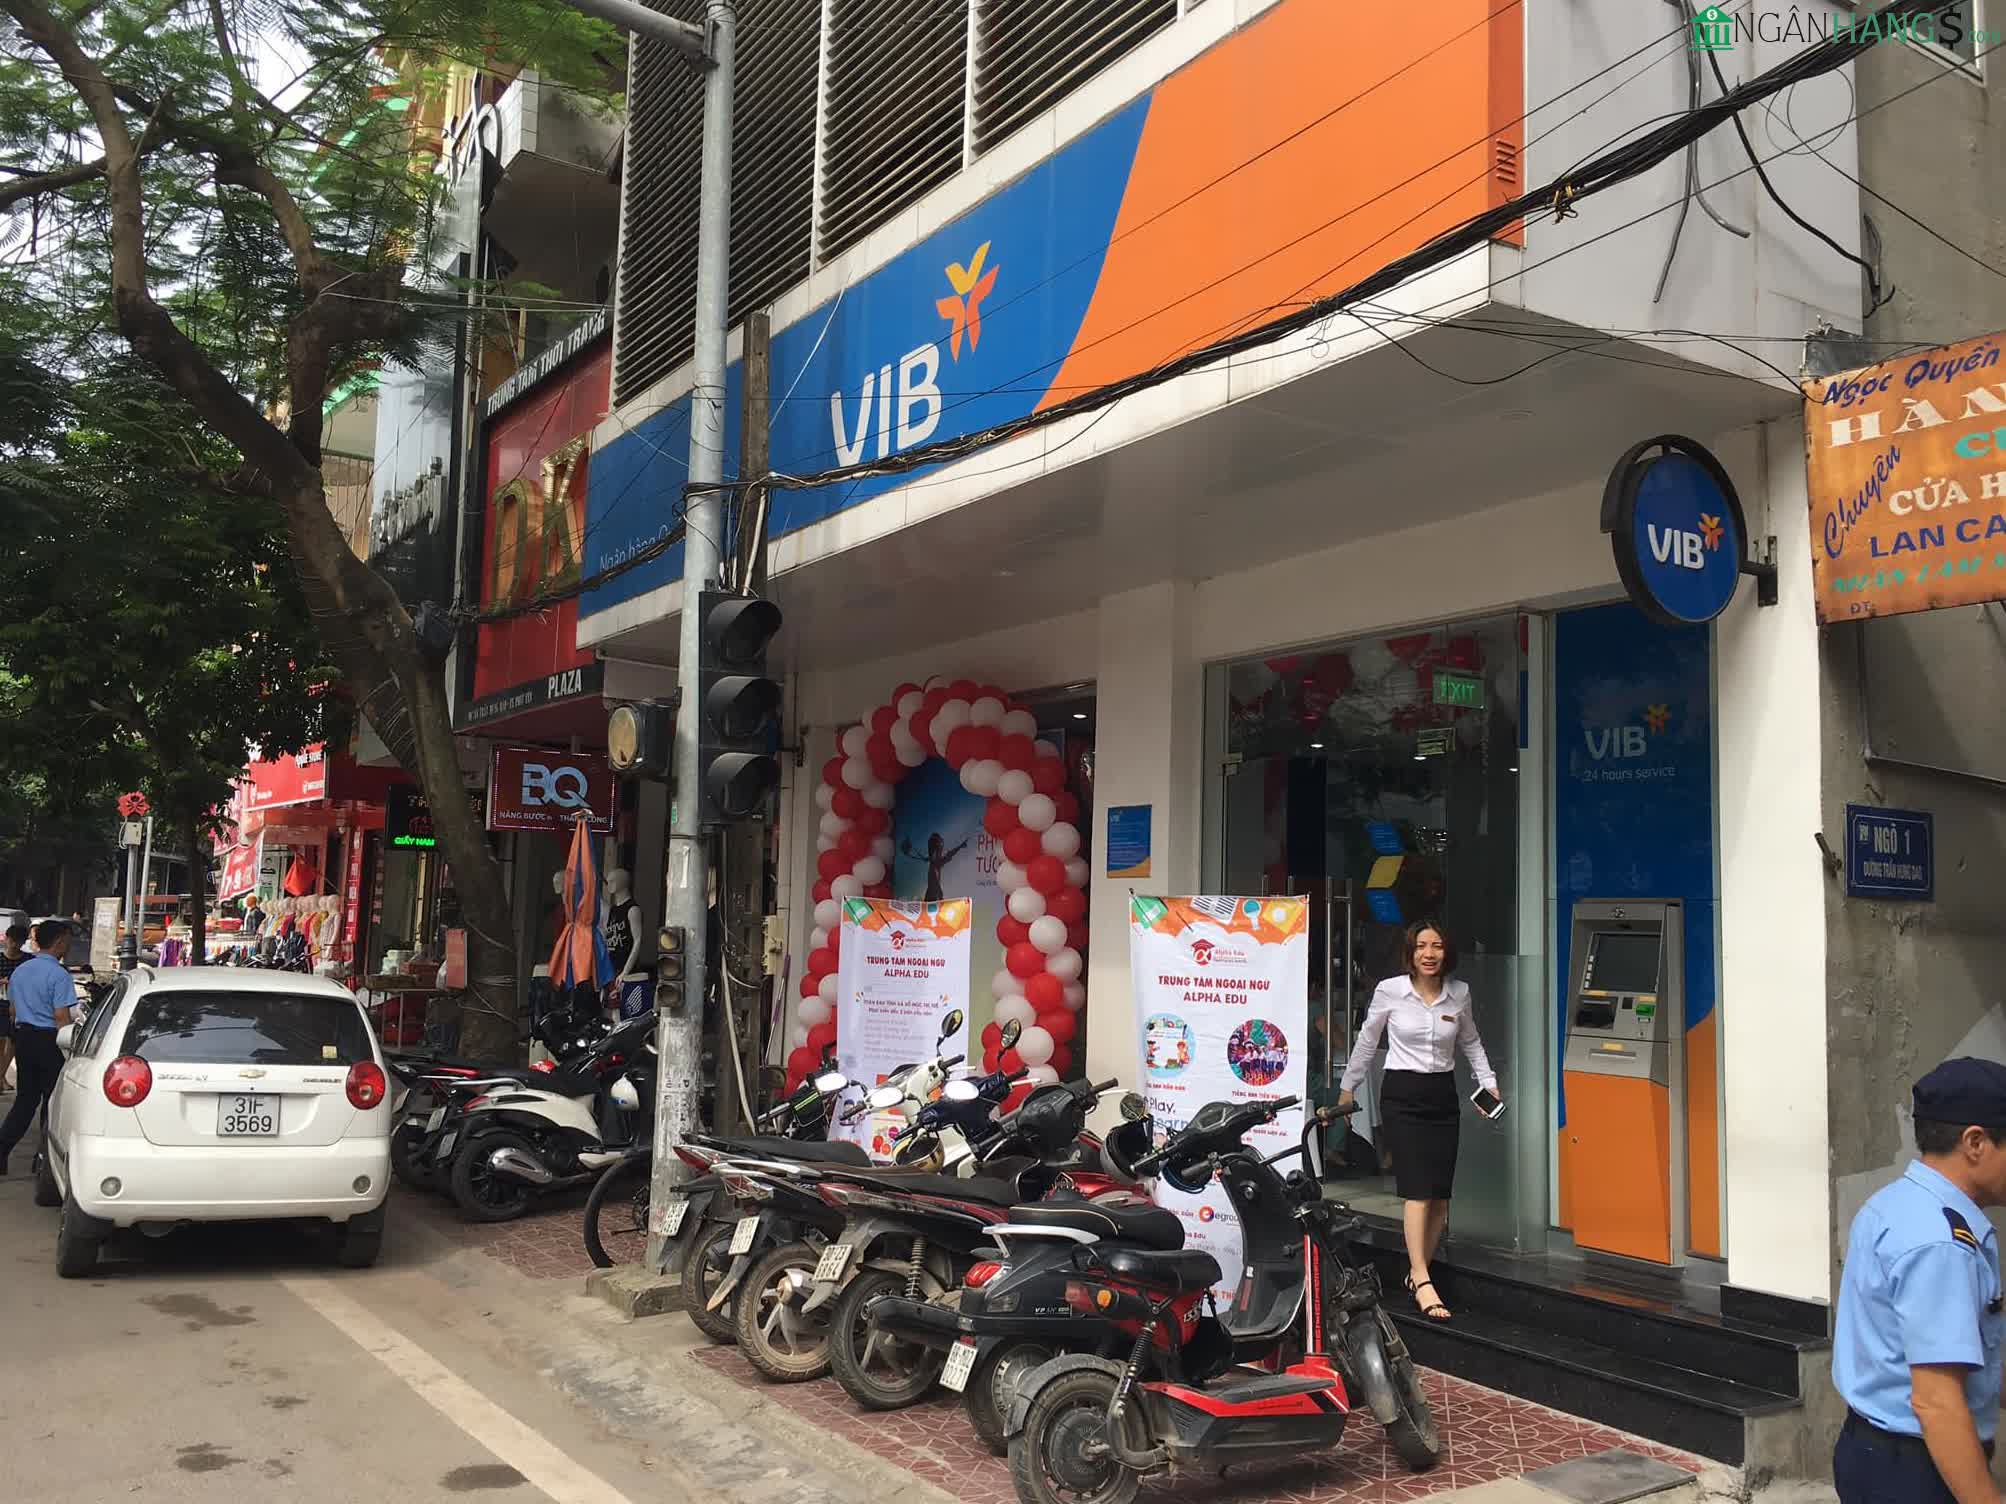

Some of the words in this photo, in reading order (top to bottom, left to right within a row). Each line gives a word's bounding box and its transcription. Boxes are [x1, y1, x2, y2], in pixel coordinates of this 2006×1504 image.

[831, 343, 942, 468] VIB
[1823, 372, 1893, 409] Ngọc
[1824, 445, 1900, 559] Chuyên
[1888, 477, 1970, 516] CỬA
[1647, 523, 1705, 570] VIB
[1870, 524, 1945, 558] LAN
[548, 668, 583, 699] PLAZA
[1584, 725, 1648, 761] VIB
[521, 762, 593, 809] BQ
[1584, 768, 1599, 782] 24
[1602, 767, 1633, 782] hours
[1635, 765, 1677, 779] service
[1904, 828, 1911, 856] 1
[866, 956, 890, 966] TRUNG
[884, 968, 911, 978] ALPHA
[913, 970, 929, 979] EDU
[1158, 975, 1191, 987] TRUNG
[1183, 991, 1222, 1004] ALPHA
[1225, 993, 1248, 1005] EDU
[224, 1115, 272, 1133] 3569
